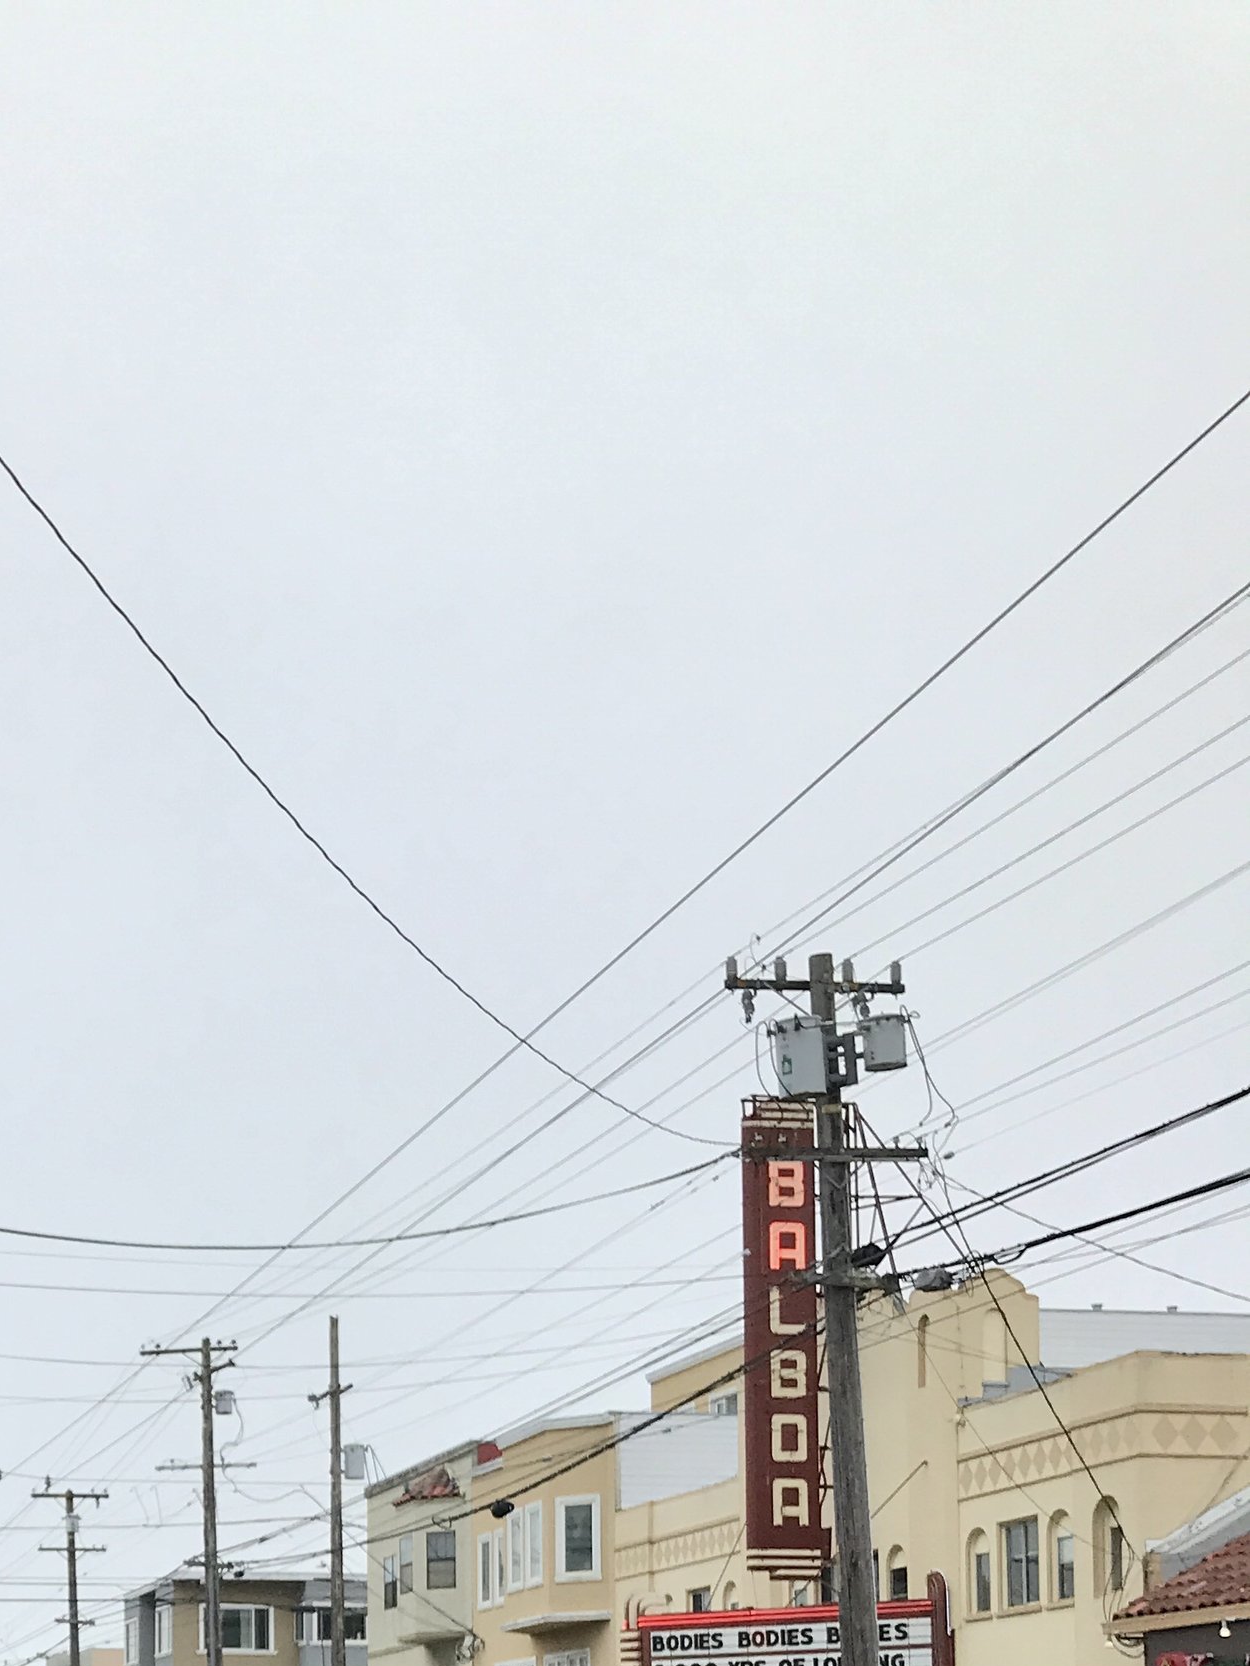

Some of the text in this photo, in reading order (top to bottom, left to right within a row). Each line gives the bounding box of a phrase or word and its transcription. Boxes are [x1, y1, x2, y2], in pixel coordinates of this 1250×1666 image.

[767, 1160, 810, 1528] BALBOA
[652, 1622, 908, 1652] BODIES BODIES BES
